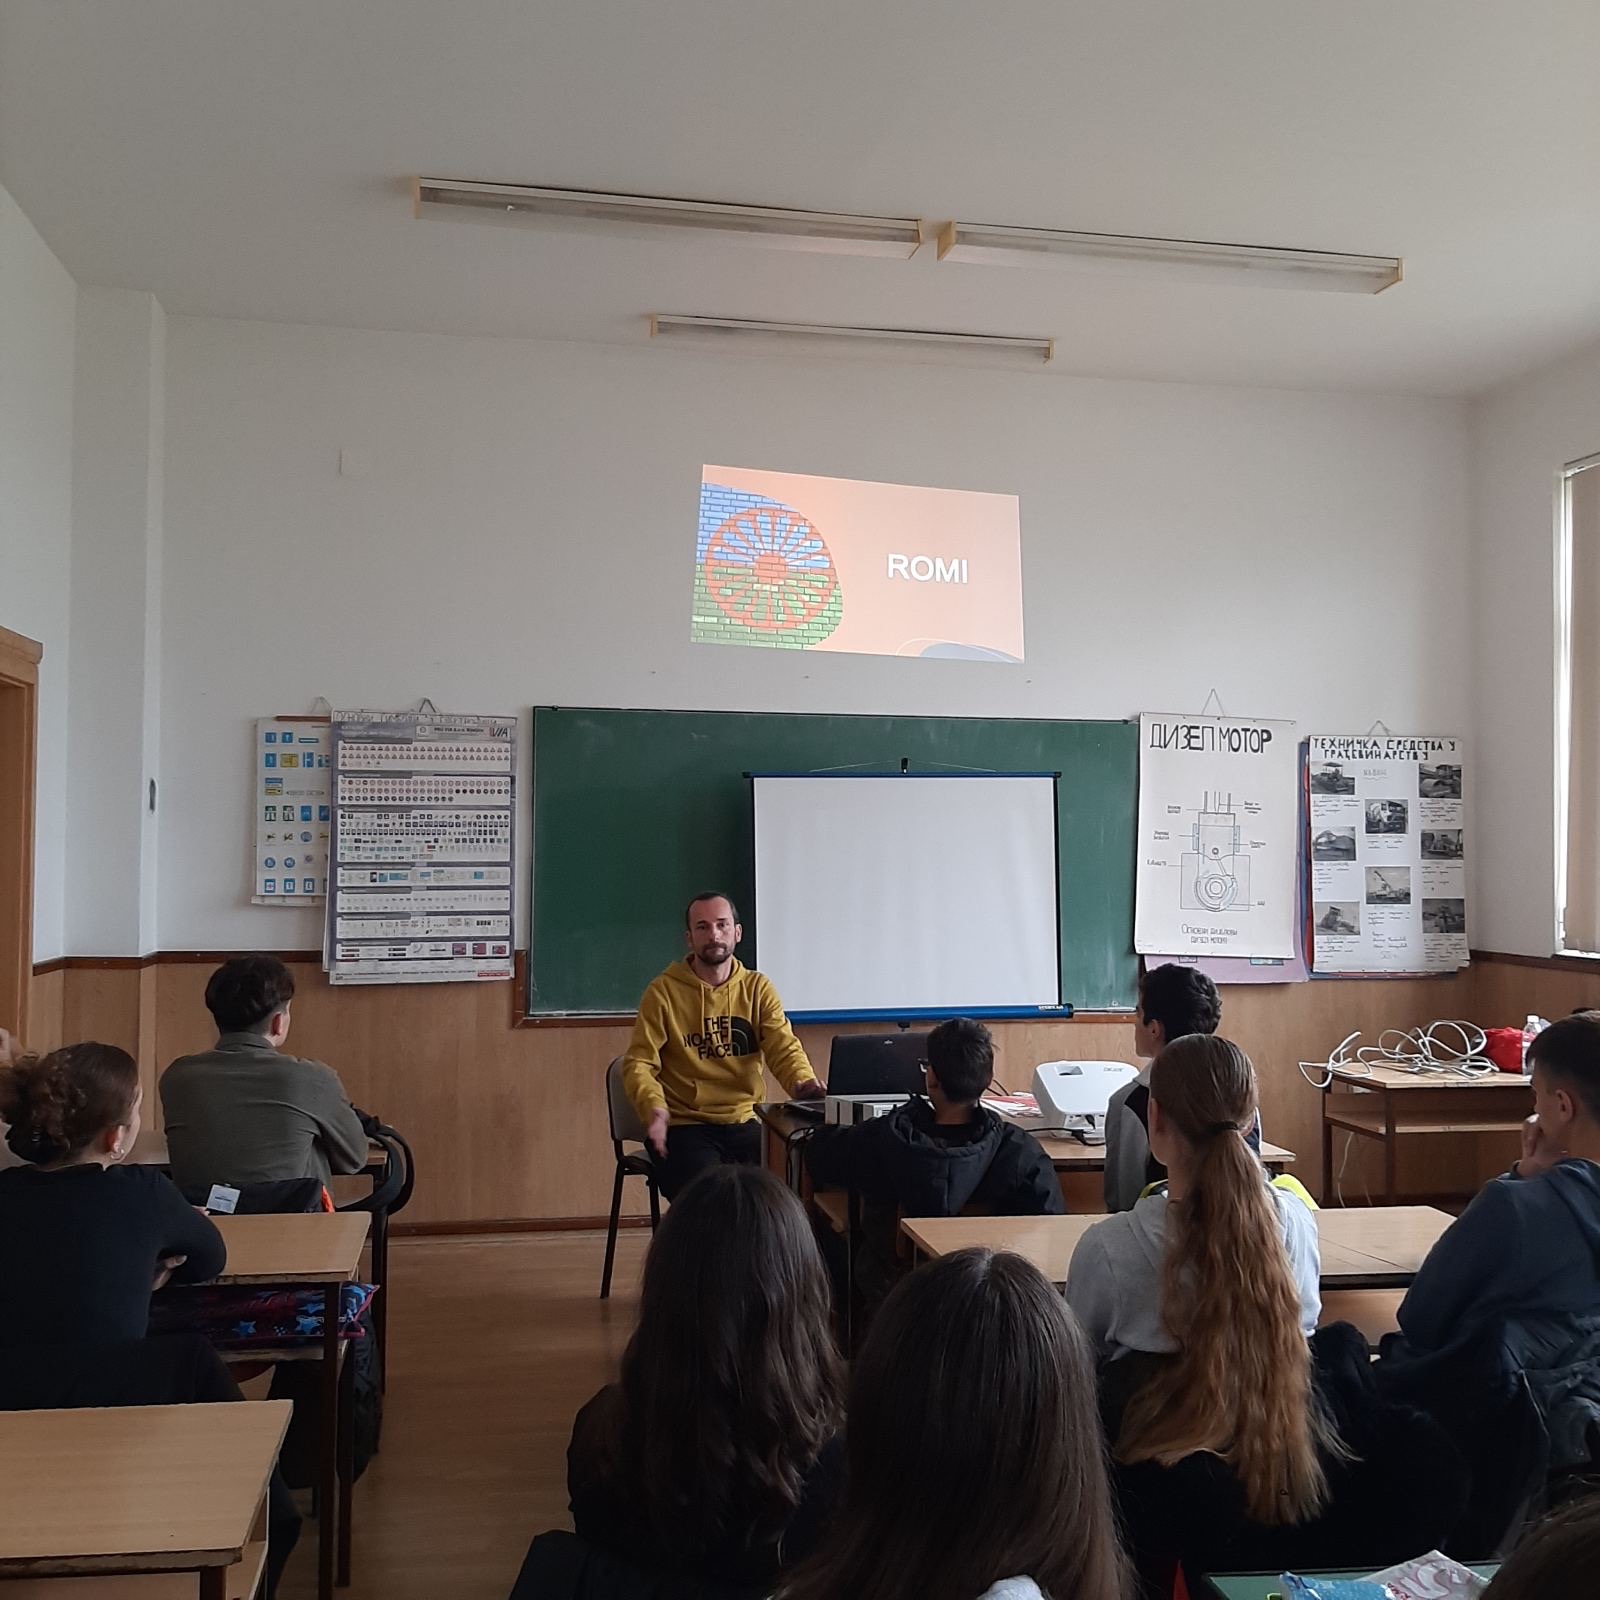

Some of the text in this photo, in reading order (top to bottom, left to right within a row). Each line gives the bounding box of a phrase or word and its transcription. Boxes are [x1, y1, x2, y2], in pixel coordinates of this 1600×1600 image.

[886, 553, 968, 585] ROMI
[1218, 726, 1272, 753] МОТОР
[1313, 738, 1380, 750] ТЕХНИЧКА
[1386, 740, 1444, 751] СРЕДСТВА
[704, 1016, 729, 1031] THE
[683, 1030, 729, 1048] NORTH
[697, 1043, 732, 1060] FACE
